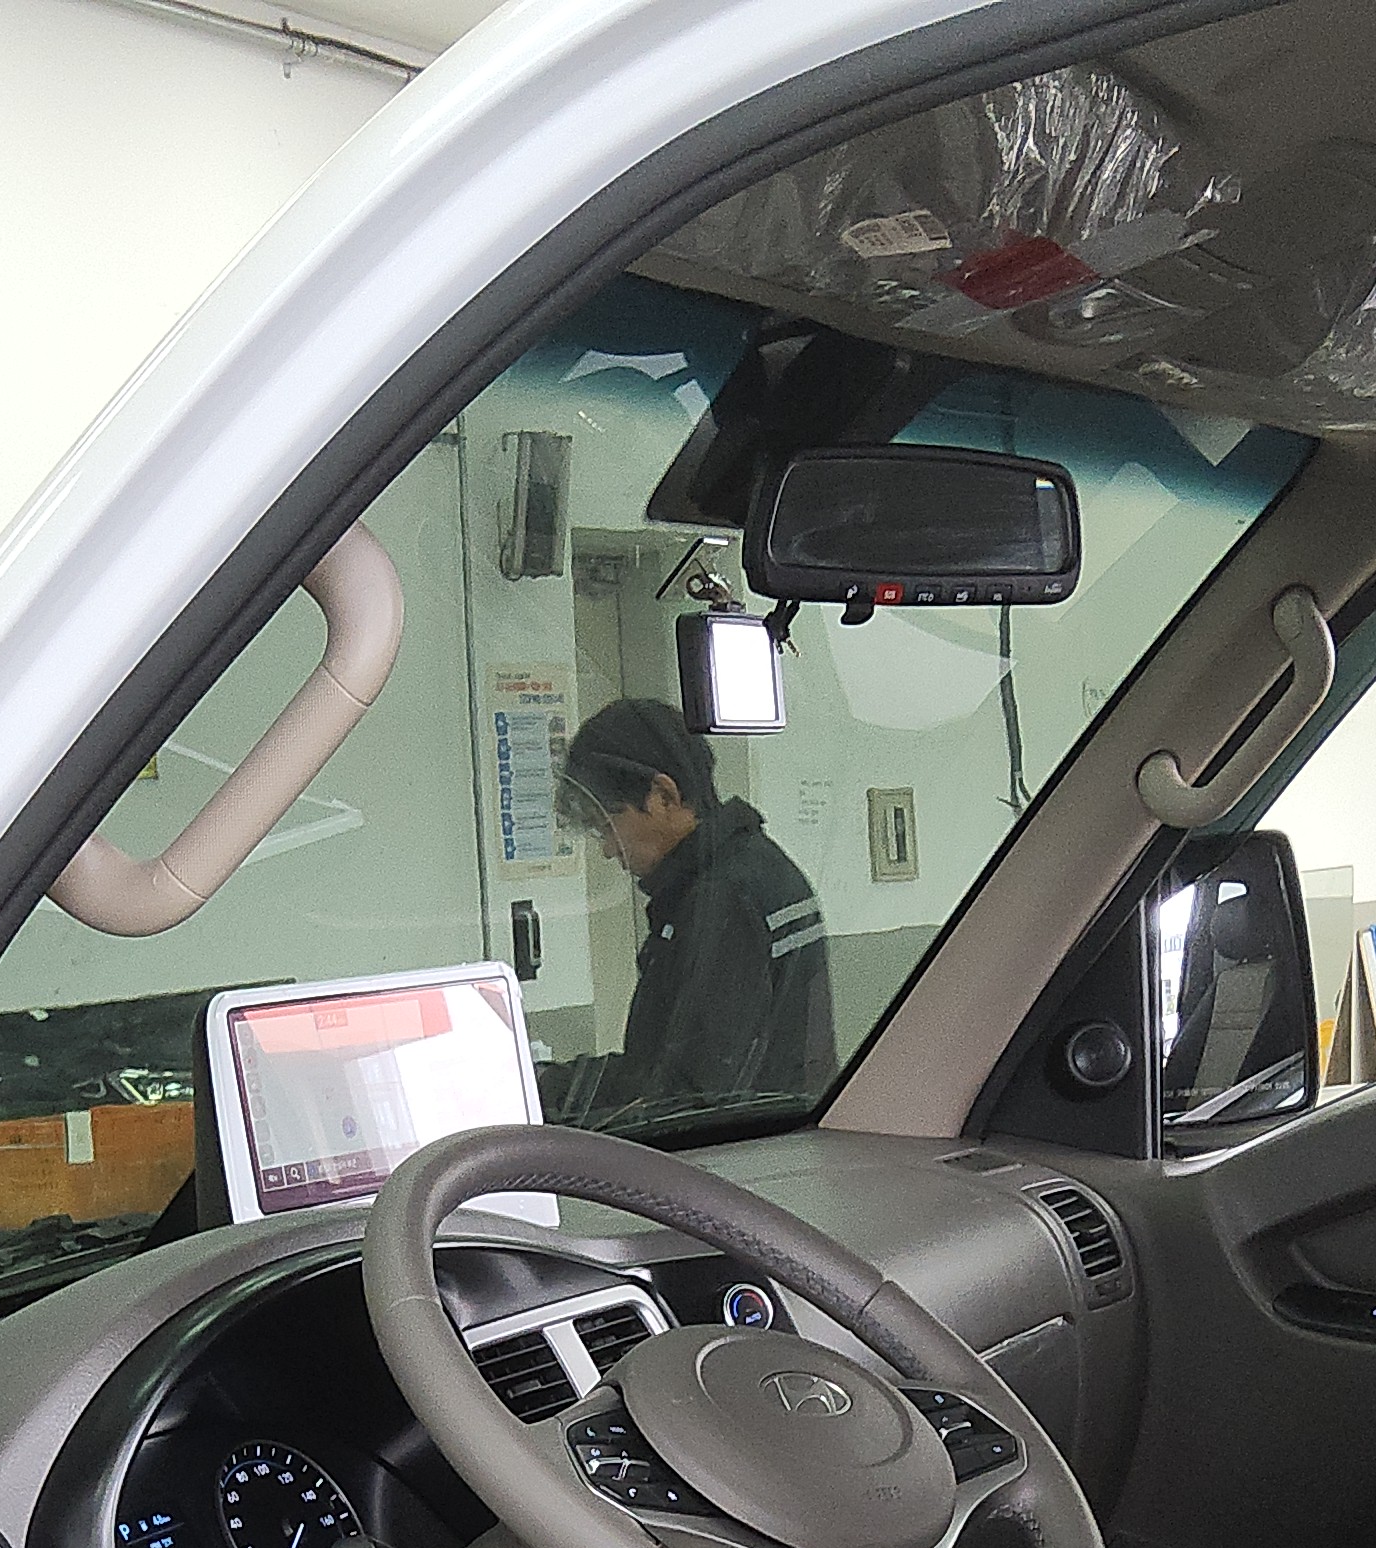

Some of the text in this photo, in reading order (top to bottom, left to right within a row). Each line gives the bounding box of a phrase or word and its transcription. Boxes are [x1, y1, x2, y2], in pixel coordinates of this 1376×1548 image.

[235, 1470, 249, 1483] 80
[253, 1463, 270, 1477] 100
[277, 1471, 294, 1485] 120
[226, 1490, 240, 1504] 60
[300, 1489, 317, 1503] 140
[229, 1517, 243, 1529] 40
[319, 1514, 335, 1527] 160
[118, 1523, 131, 1541] P
